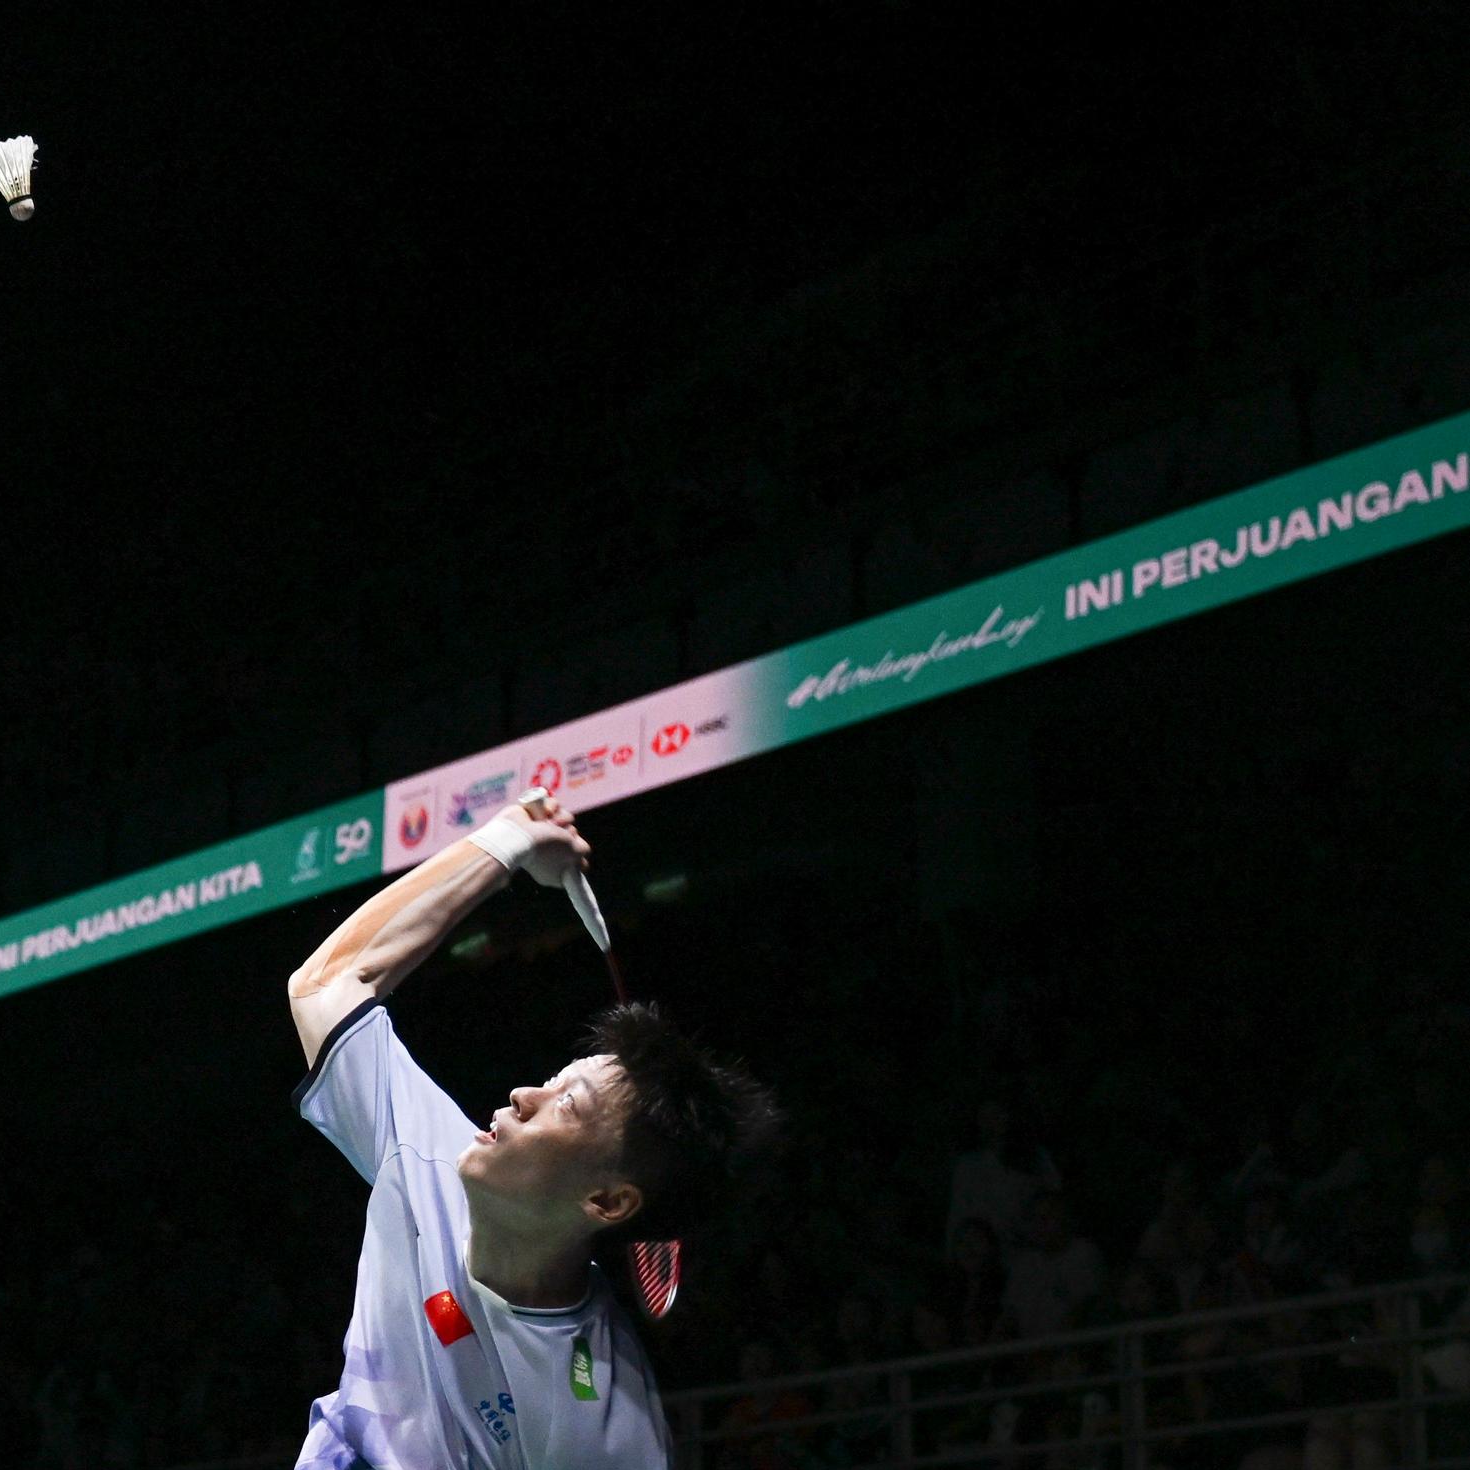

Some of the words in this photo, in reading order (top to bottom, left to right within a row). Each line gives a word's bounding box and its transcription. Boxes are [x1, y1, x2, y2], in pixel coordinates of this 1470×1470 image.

[1065, 569, 1123, 621] INI
[1132, 453, 1469, 599] PERJUANGAN
[200, 861, 261, 904] KITA
